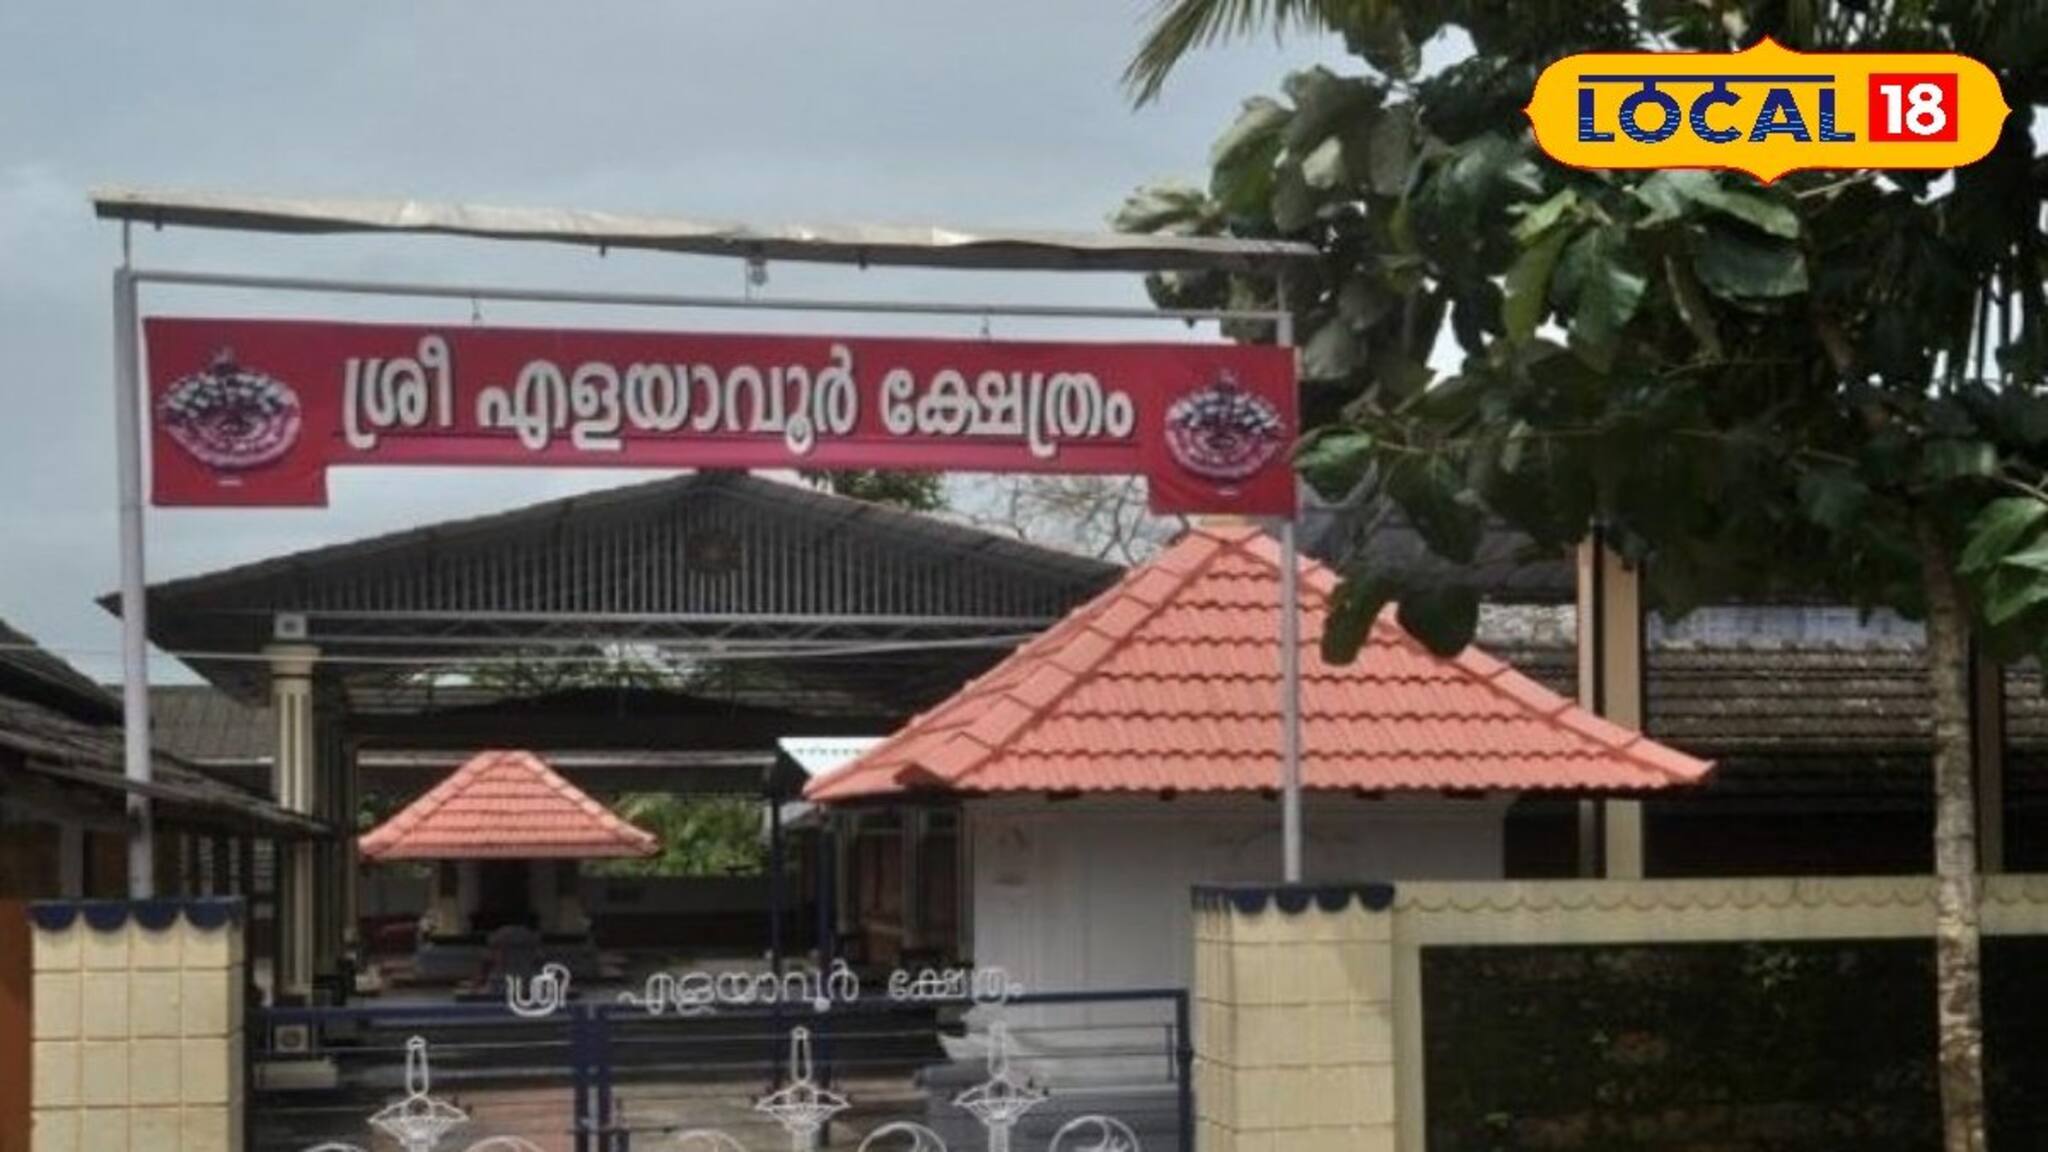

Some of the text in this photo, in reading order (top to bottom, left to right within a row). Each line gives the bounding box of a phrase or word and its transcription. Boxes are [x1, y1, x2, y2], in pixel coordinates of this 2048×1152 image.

[343, 334, 1135, 458] ശ്രീ എളയാവൂർ ക്ഷേത്രം
